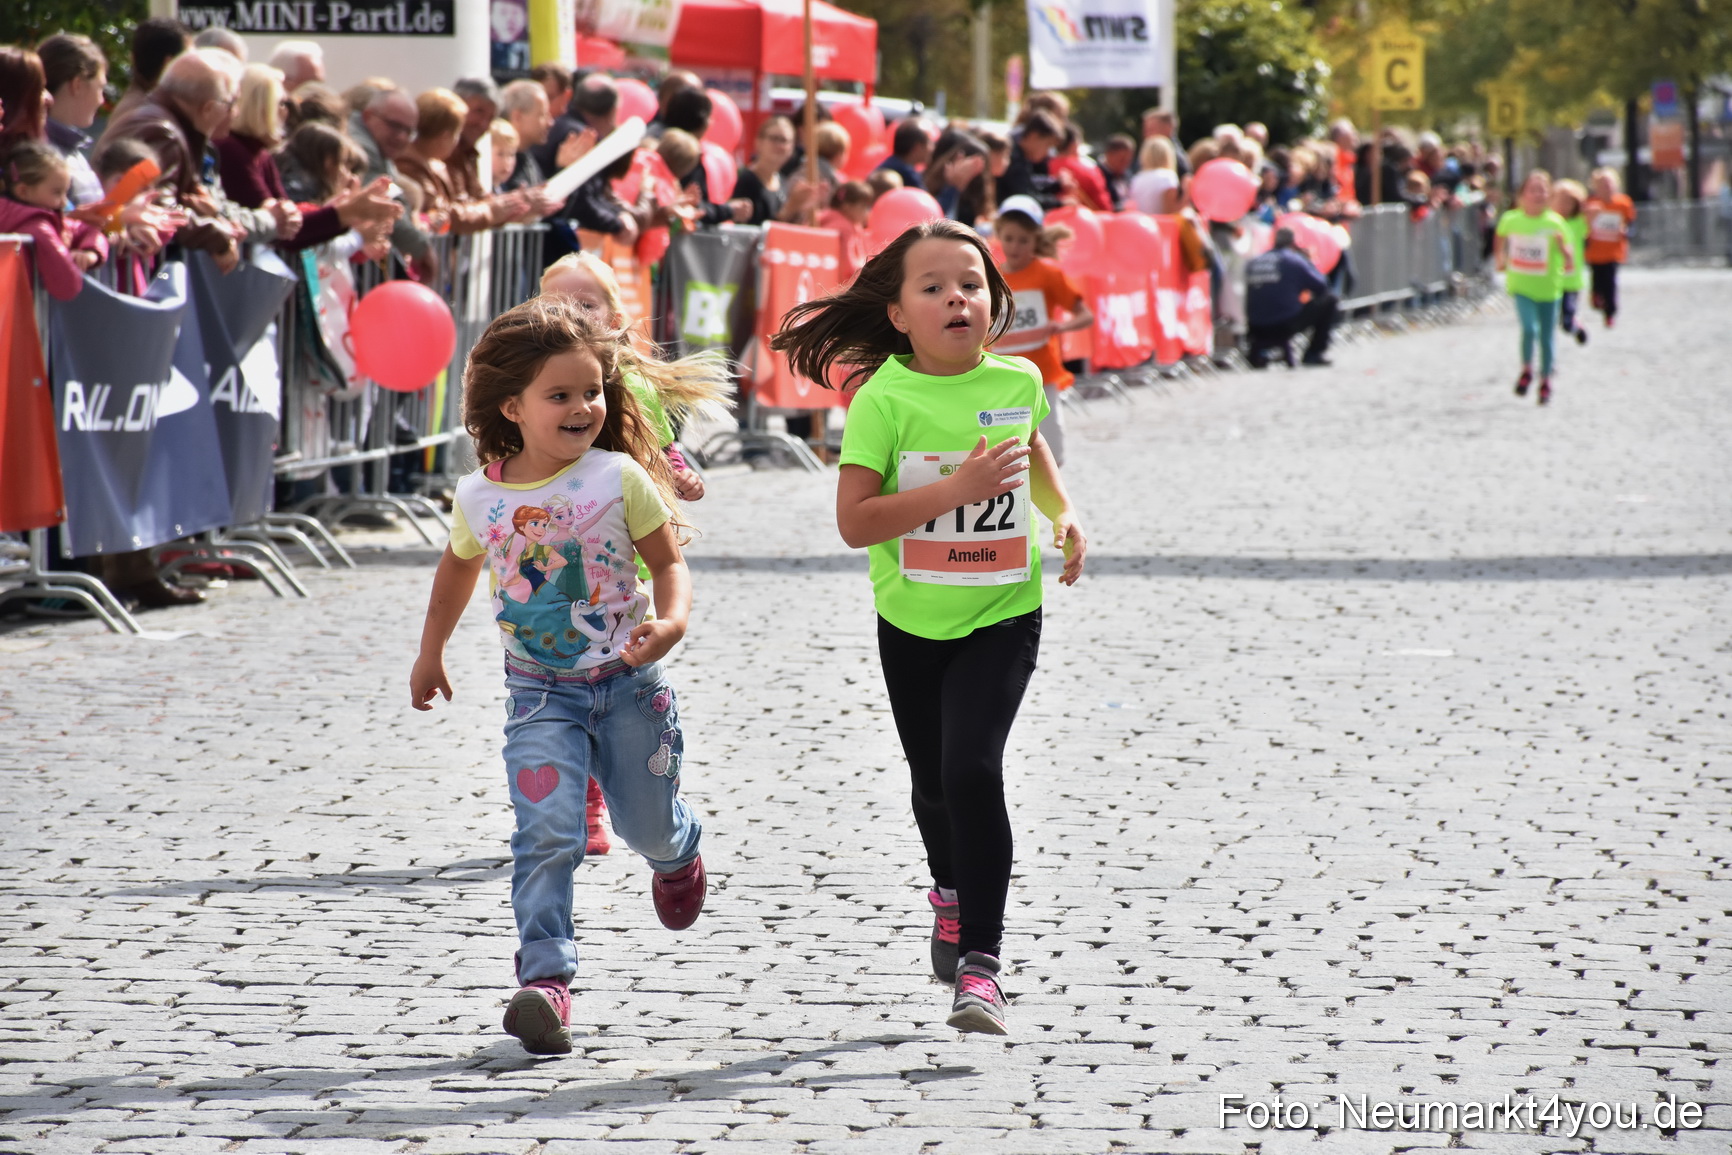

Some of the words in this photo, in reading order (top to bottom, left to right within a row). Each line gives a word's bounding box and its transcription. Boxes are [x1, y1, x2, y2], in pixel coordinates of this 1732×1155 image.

[1385, 57, 1410, 93] C
[1012, 307, 1038, 328] 58
[575, 499, 598, 520] Love
[587, 534, 601, 544] and
[947, 547, 997, 562] Amelie
[588, 566, 612, 583] Fairy
